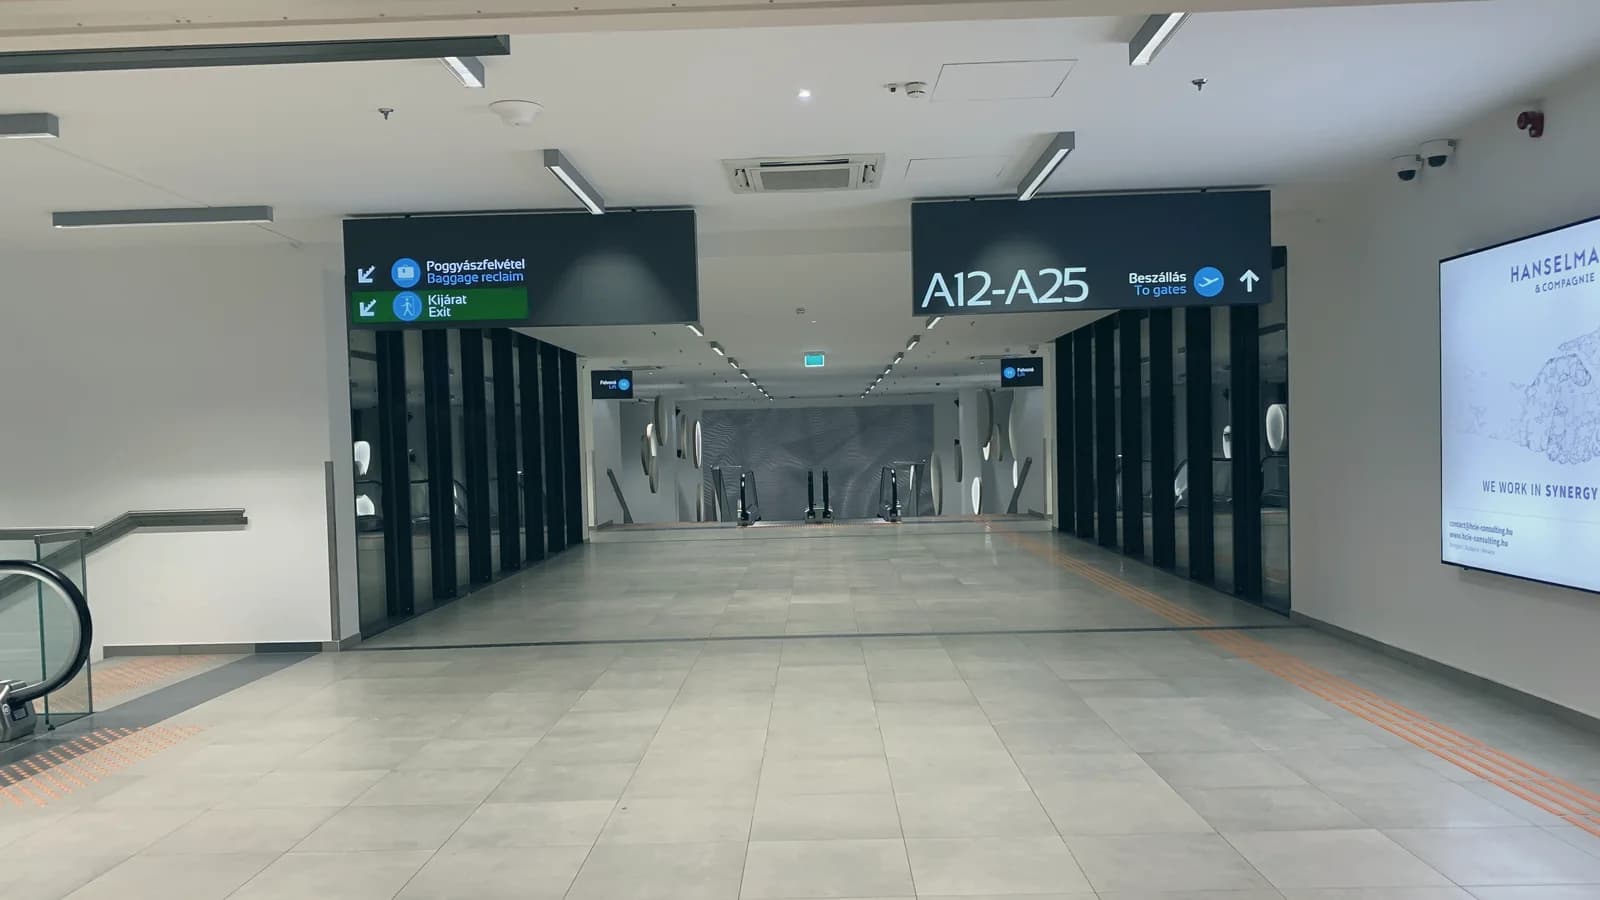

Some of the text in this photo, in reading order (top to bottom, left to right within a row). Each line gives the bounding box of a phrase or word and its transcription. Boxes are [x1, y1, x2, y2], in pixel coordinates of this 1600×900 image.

[426, 258, 526, 274] Poggyászfelvétel
[1511, 246, 1600, 283] HANSELMA
[427, 271, 525, 286] Baggage reclaim
[1128, 271, 1188, 284] Beszállás
[1535, 272, 1596, 294] & COMPAGNIE
[921, 267, 1090, 309] A12-A25
[1134, 284, 1188, 298] To gates
[427, 294, 468, 308] Kijárat
[428, 306, 452, 318] Exit
[1482, 479, 1599, 501] WE WORK IN SYNERGY
